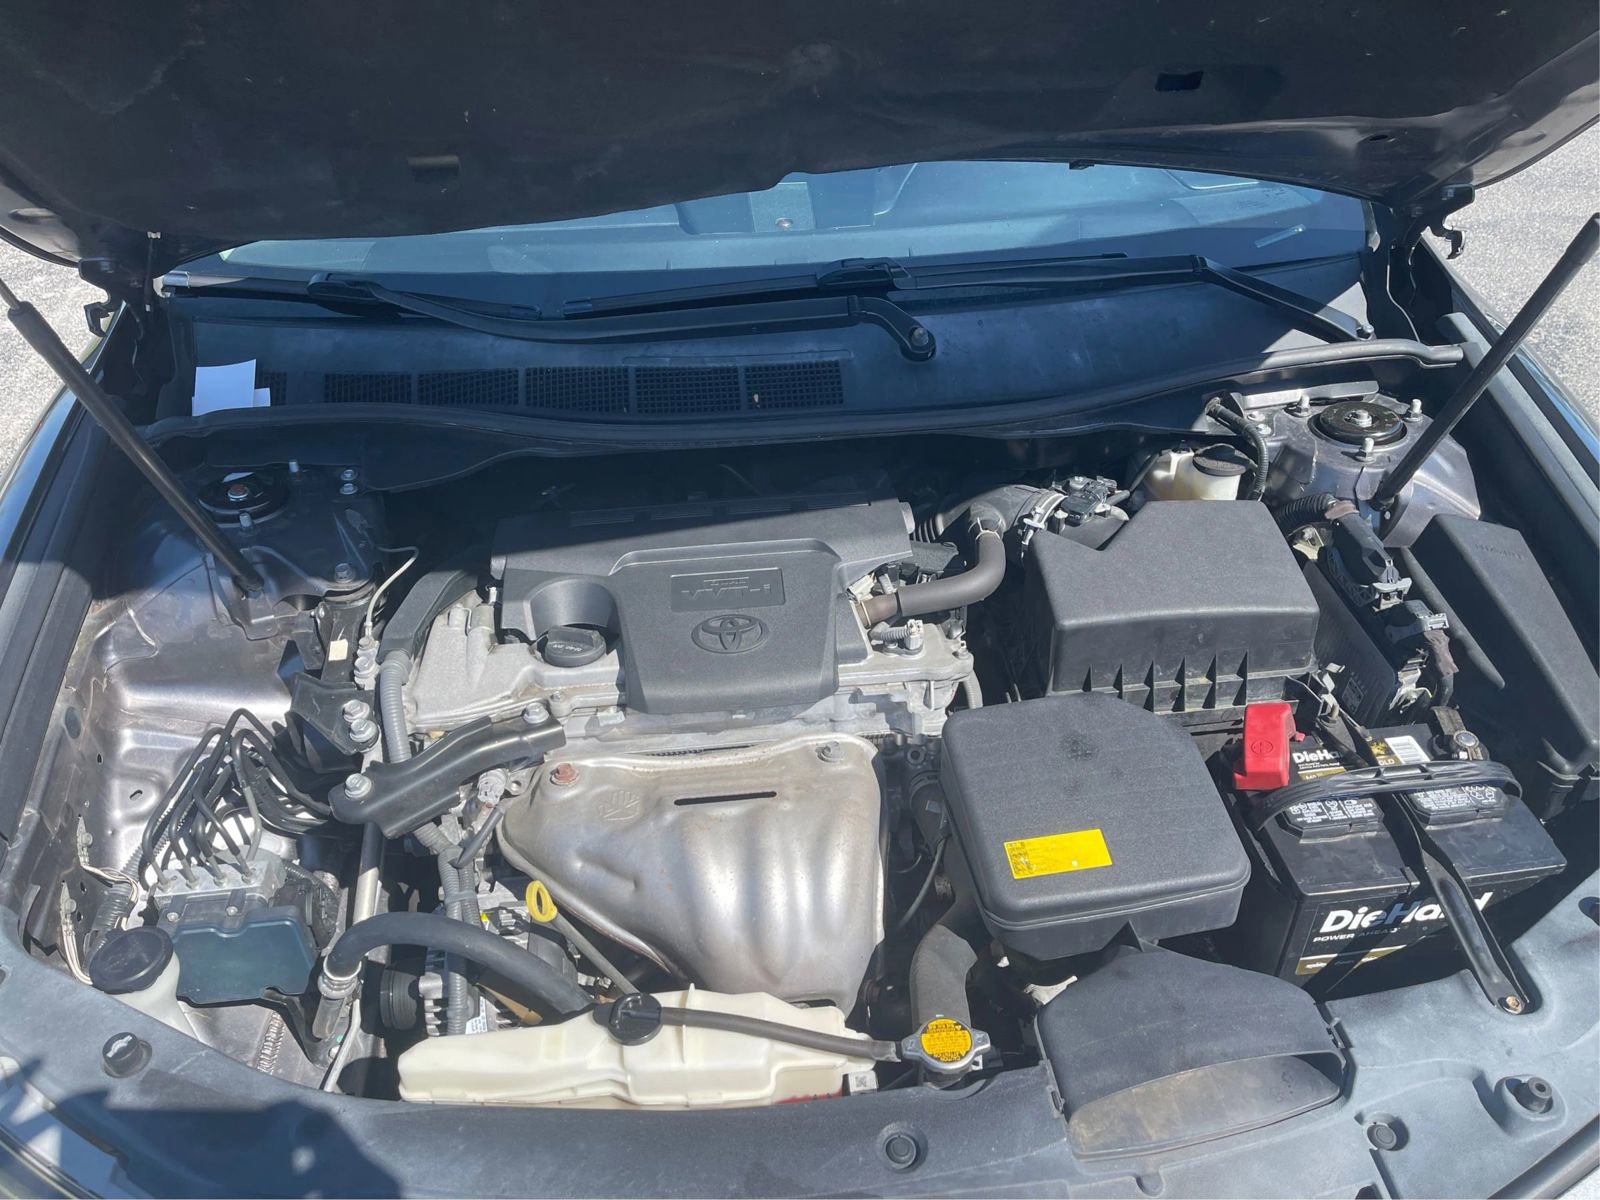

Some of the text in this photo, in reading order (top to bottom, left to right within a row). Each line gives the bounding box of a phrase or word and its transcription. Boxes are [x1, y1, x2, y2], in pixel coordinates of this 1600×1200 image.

[1292, 749, 1341, 764] DieHa
[1319, 891, 1494, 933] DieHad
[1313, 933, 1355, 943] POWER
